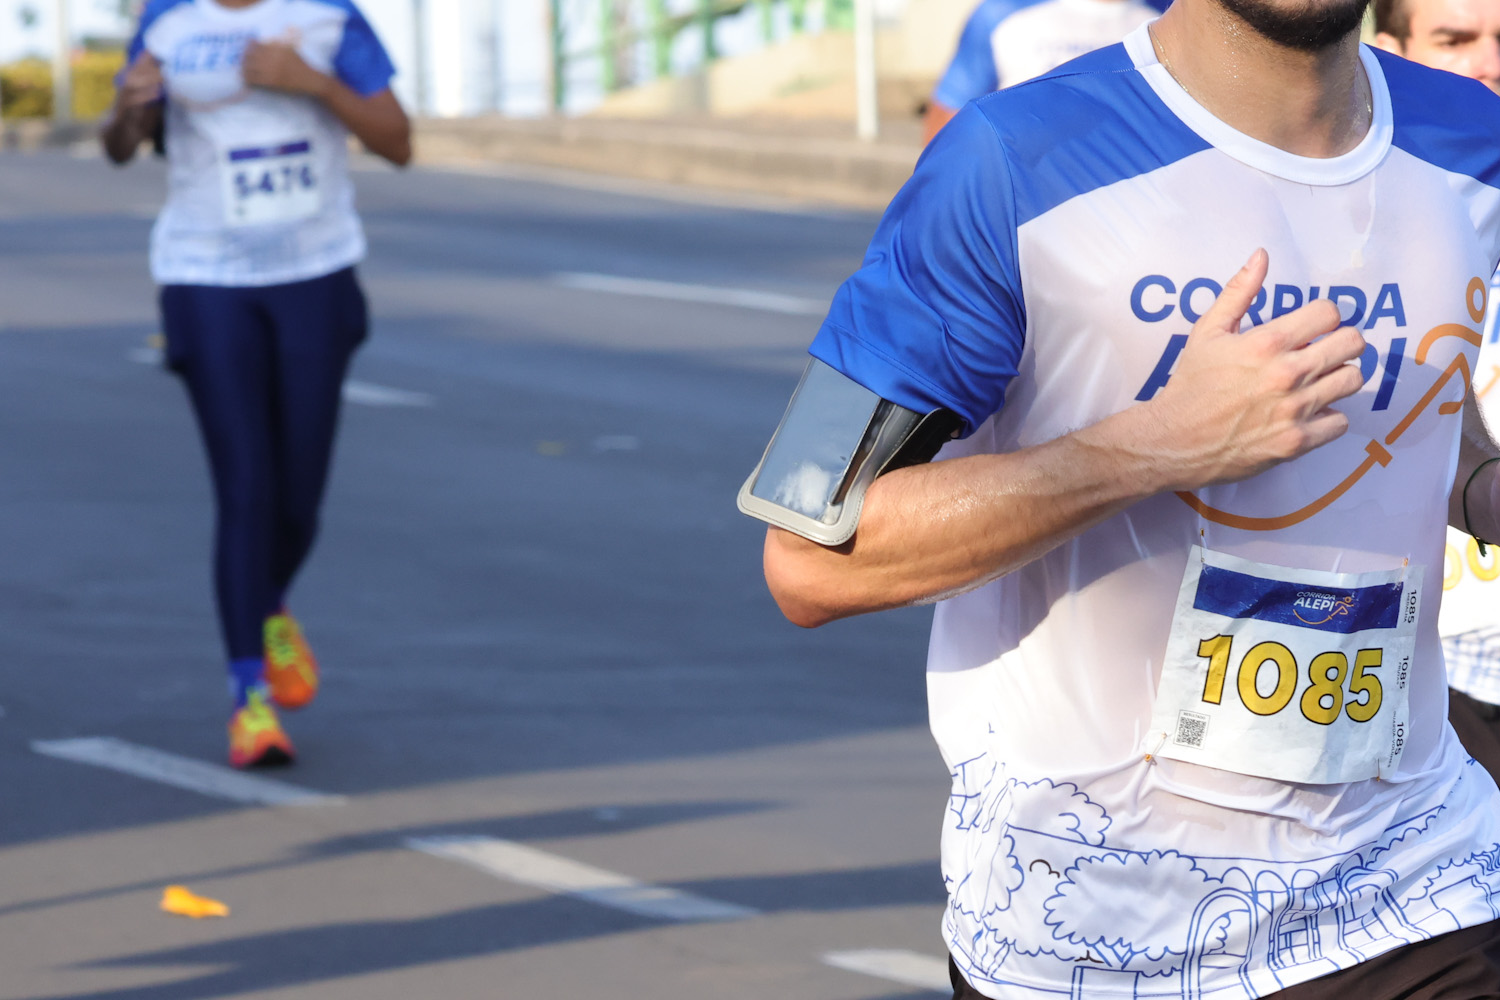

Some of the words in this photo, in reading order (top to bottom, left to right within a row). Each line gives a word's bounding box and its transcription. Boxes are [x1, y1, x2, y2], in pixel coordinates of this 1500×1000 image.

[1293, 597, 1335, 612] ALEPI
[1296, 591, 1336, 601] CORRIDA
[1407, 589, 1417, 624] 1085
[1197, 633, 1383, 725] 1085
[1399, 655, 1409, 689] 1085
[1394, 722, 1404, 756] 1085
